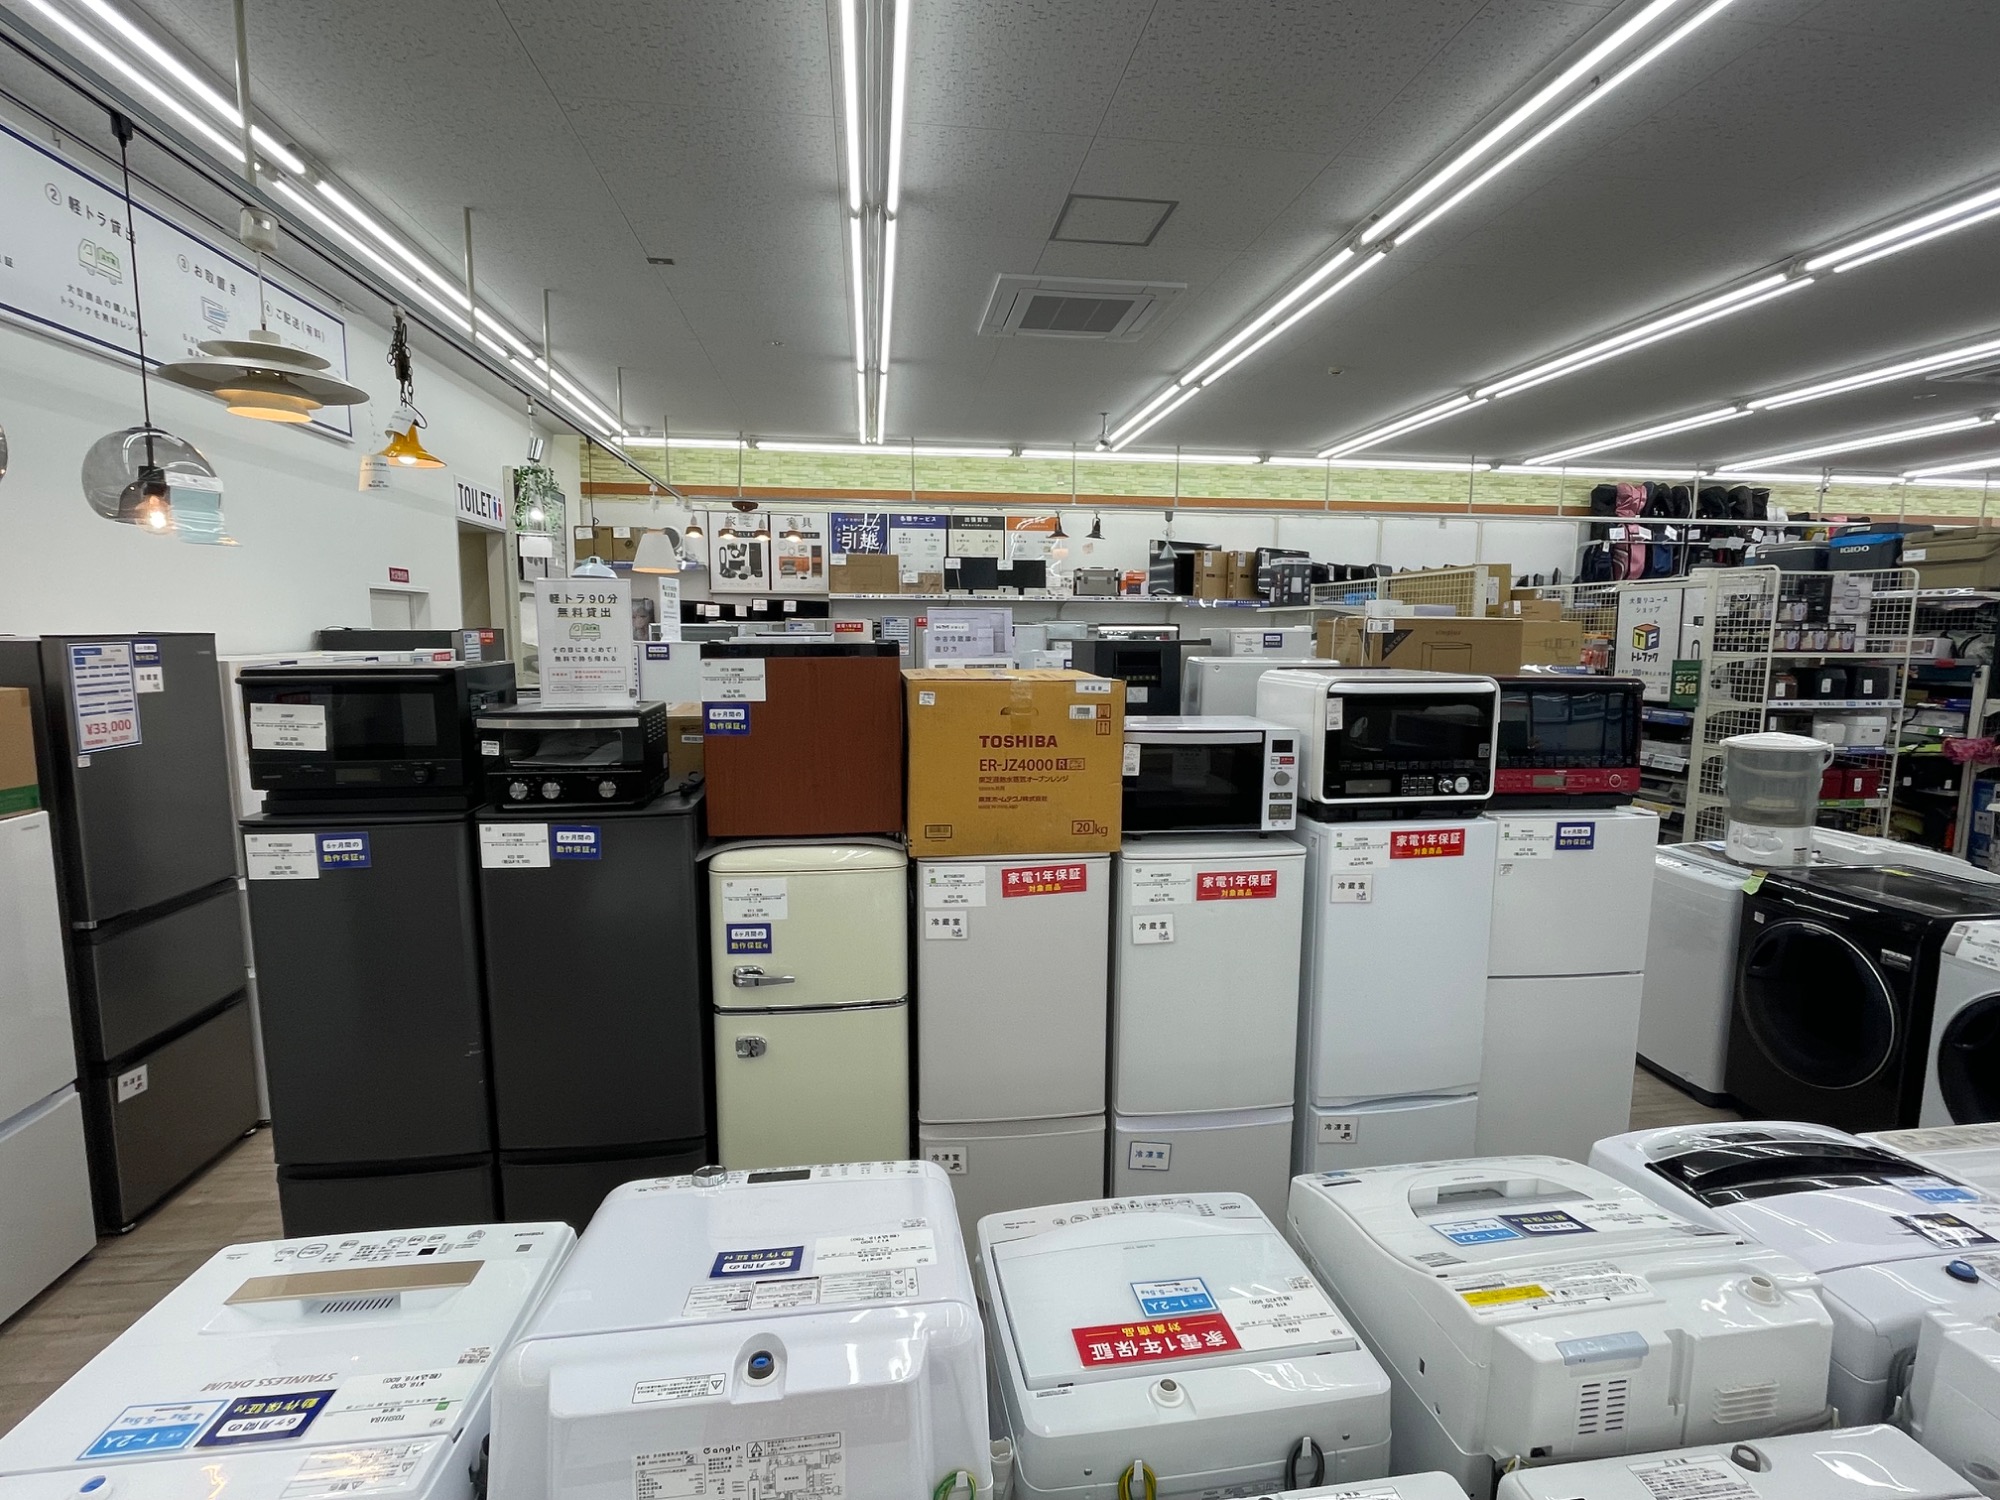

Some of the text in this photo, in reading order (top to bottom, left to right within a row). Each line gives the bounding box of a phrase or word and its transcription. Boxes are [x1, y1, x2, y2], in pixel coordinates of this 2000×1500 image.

[68, 196, 137, 244] 軽トラ貸出
[194, 265, 237, 297] お取置き
[458, 483, 492, 519] TOILET
[841, 531, 880, 549] 引越
[1840, 545, 1869, 553] IGLOO
[549, 593, 618, 604] 軽トラ90分
[557, 607, 612, 618] 無料貸出
[1632, 652, 1658, 662] トレファク
[1675, 682, 1697, 694] 5倍
[86, 720, 131, 735] ¥33,000
[709, 722, 746, 730] 動作保証付
[979, 735, 1057, 748] TOSHIBA
[980, 759, 1053, 771] ER-JZ4000
[1077, 823, 1108, 836] 20 kg
[1396, 832, 1461, 847] 家電1年保証
[1413, 847, 1443, 855] 対象商品
[324, 854, 365, 862] 動作保証付
[1008, 868, 1081, 885] 家電1年保証
[1202, 874, 1272, 888] 家電1年保証
[1028, 883, 1061, 893] 対象商品
[1221, 889, 1253, 897] 対象商品
[931, 918, 960, 926] 冷蔵室
[1138, 921, 1167, 930] 冷蔵室
[1324, 1123, 1351, 1131] 冷凍室
[1135, 1150, 1165, 1159] 冷凍室
[724, 1251, 794, 1260] 動作保証付
[729, 1261, 785, 1270] 6ヶ月間の
[1121, 1321, 1181, 1337] 対象商品
[1088, 1330, 1227, 1361] 家電1年保証
[201, 1372, 338, 1392] STAINLESS DRUM
[233, 1398, 320, 1414] 動作保証付
[228, 1417, 297, 1432] 6ヶ月間の
[370, 1414, 405, 1424] TOSHIBA
